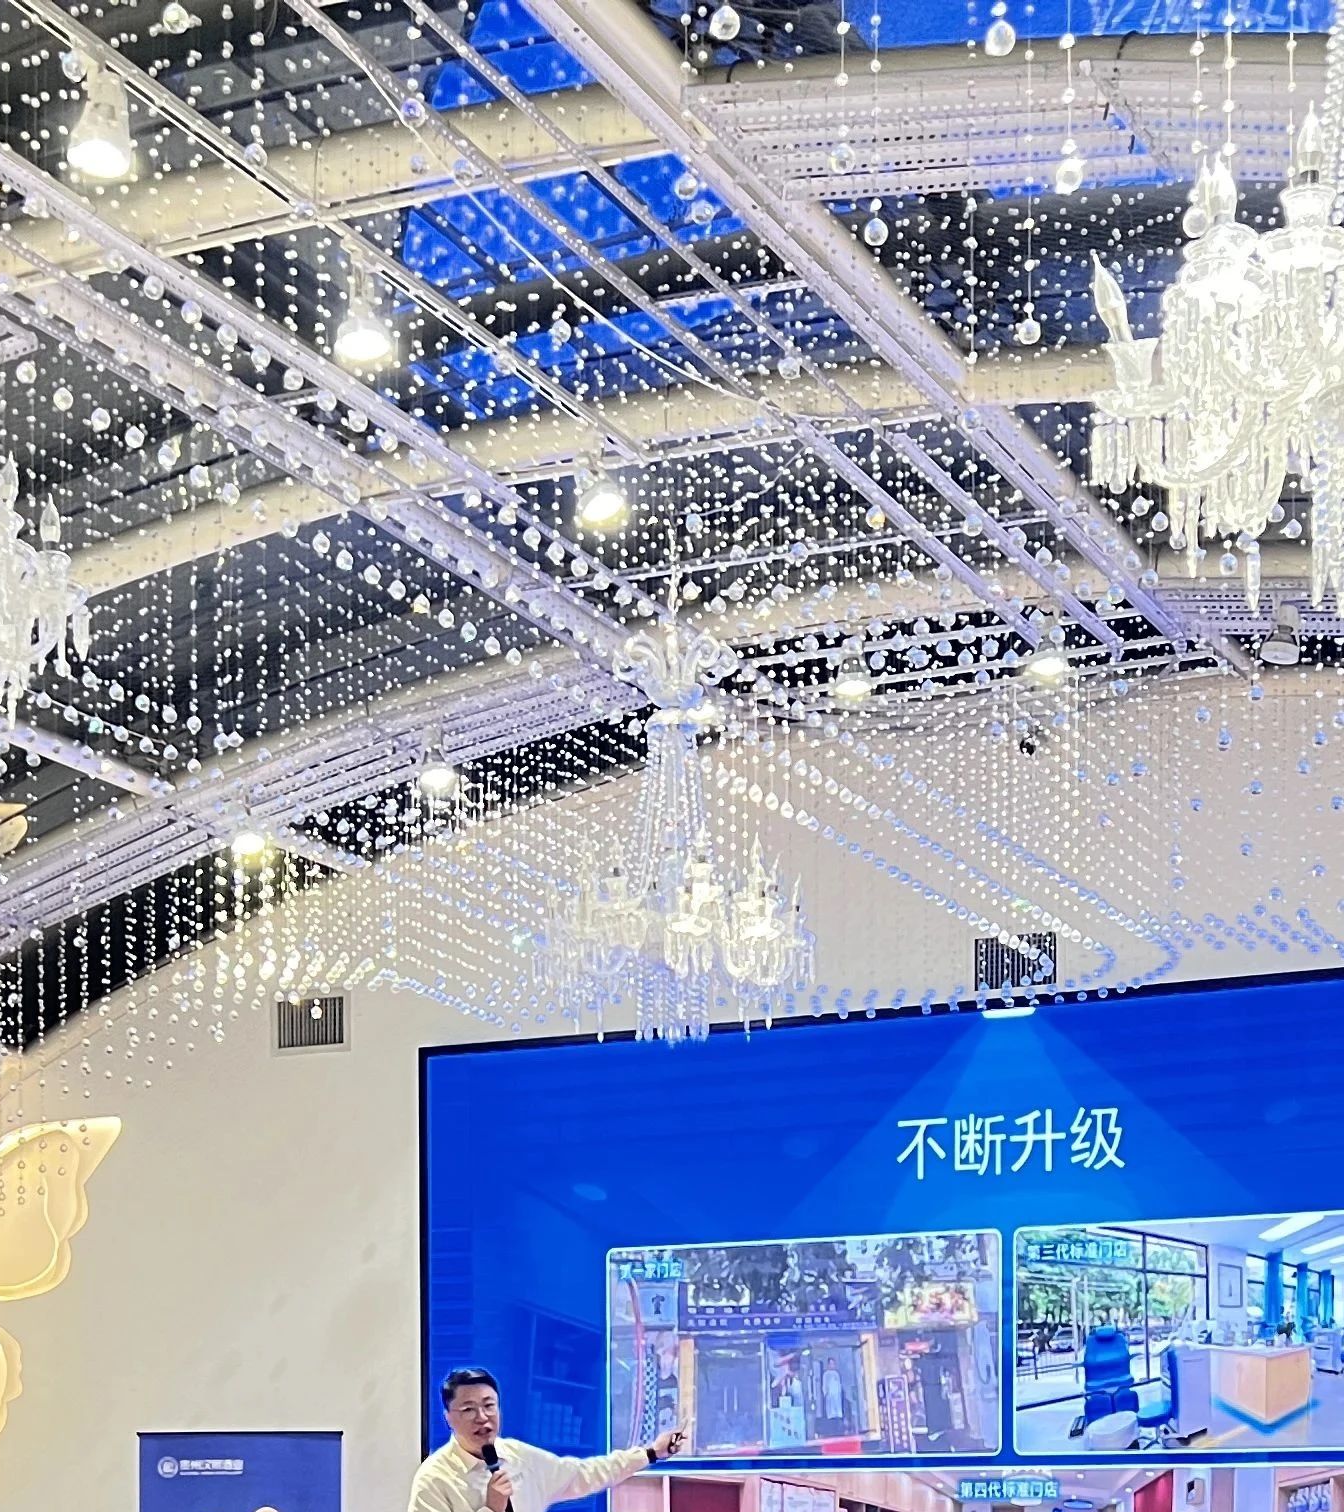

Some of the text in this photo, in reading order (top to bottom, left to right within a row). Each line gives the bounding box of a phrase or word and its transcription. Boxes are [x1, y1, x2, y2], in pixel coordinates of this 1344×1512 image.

[896, 1106, 1126, 1180] 不断升级
[1027, 1241, 1127, 1260] 第三代标准门店
[961, 1481, 1058, 1498] 第四代标准门店
